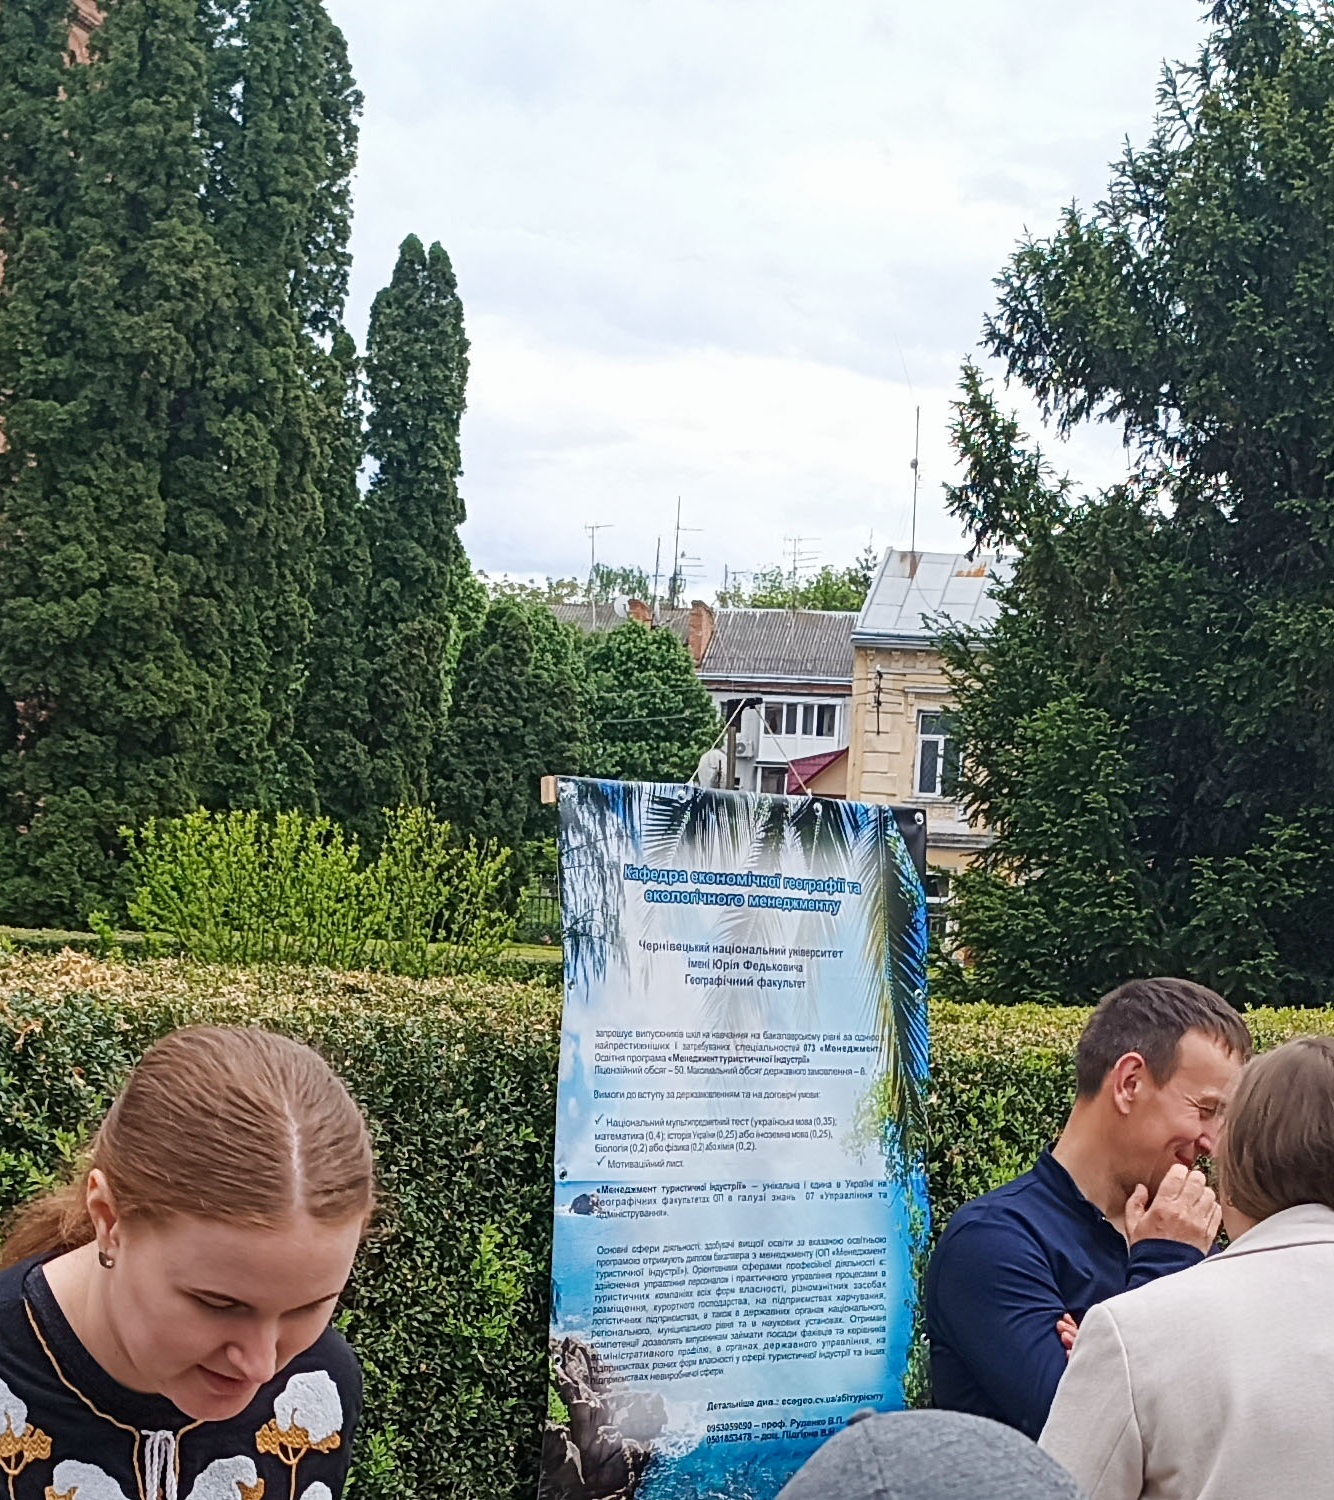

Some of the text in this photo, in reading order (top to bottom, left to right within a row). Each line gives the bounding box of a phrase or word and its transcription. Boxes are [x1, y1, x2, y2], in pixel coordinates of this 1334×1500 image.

[624, 864, 861, 895] Кафедра економічної географії та
[644, 889, 841, 915] екологічного менеджменту
[638, 940, 843, 960] Чернівецький національний університет
[688, 958, 803, 973] імені Юрія Федьковича
[685, 974, 754, 988] Географічний
